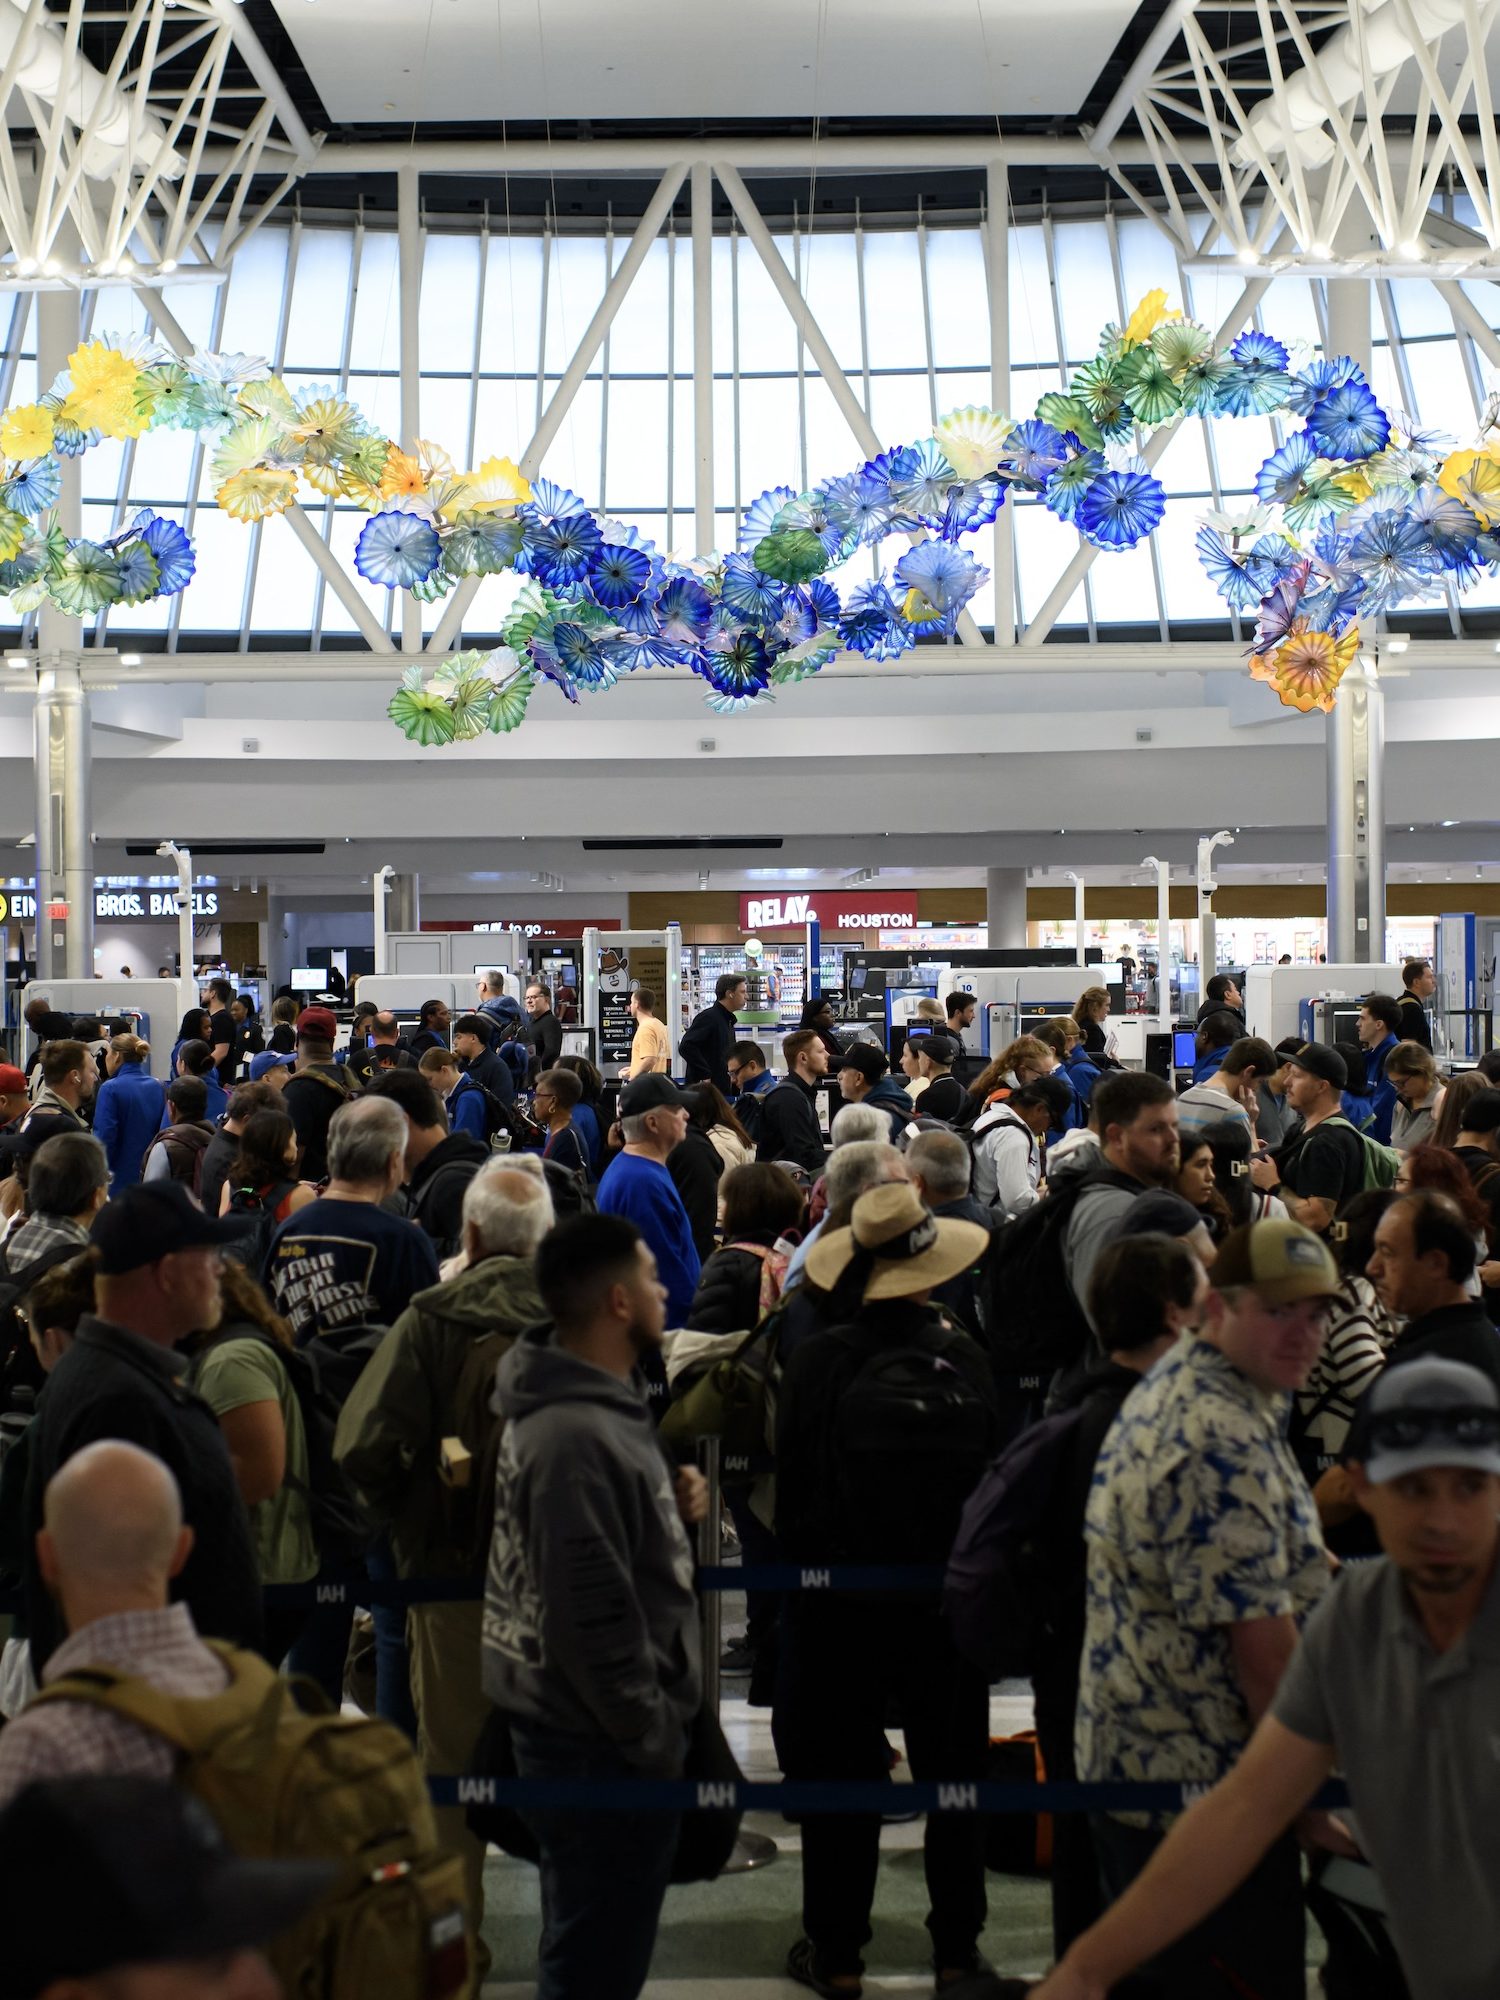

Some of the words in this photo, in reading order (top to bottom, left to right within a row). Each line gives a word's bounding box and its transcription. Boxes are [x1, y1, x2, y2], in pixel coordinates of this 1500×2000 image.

[96, 893, 145, 916] BROS.
[838, 913, 913, 928] HOUSTON
[525, 924, 542, 937] go
[961, 984, 973, 992] 10
[646, 1383, 663, 1397] AH
[1019, 1376, 1040, 1389] IAH
[725, 1456, 748, 1472] IAH
[801, 1569, 830, 1588] IAH
[316, 1585, 346, 1603] IAH
[457, 1779, 496, 1804] IAH
[697, 1782, 737, 1809] IAH
[937, 1784, 978, 1808] IAH
